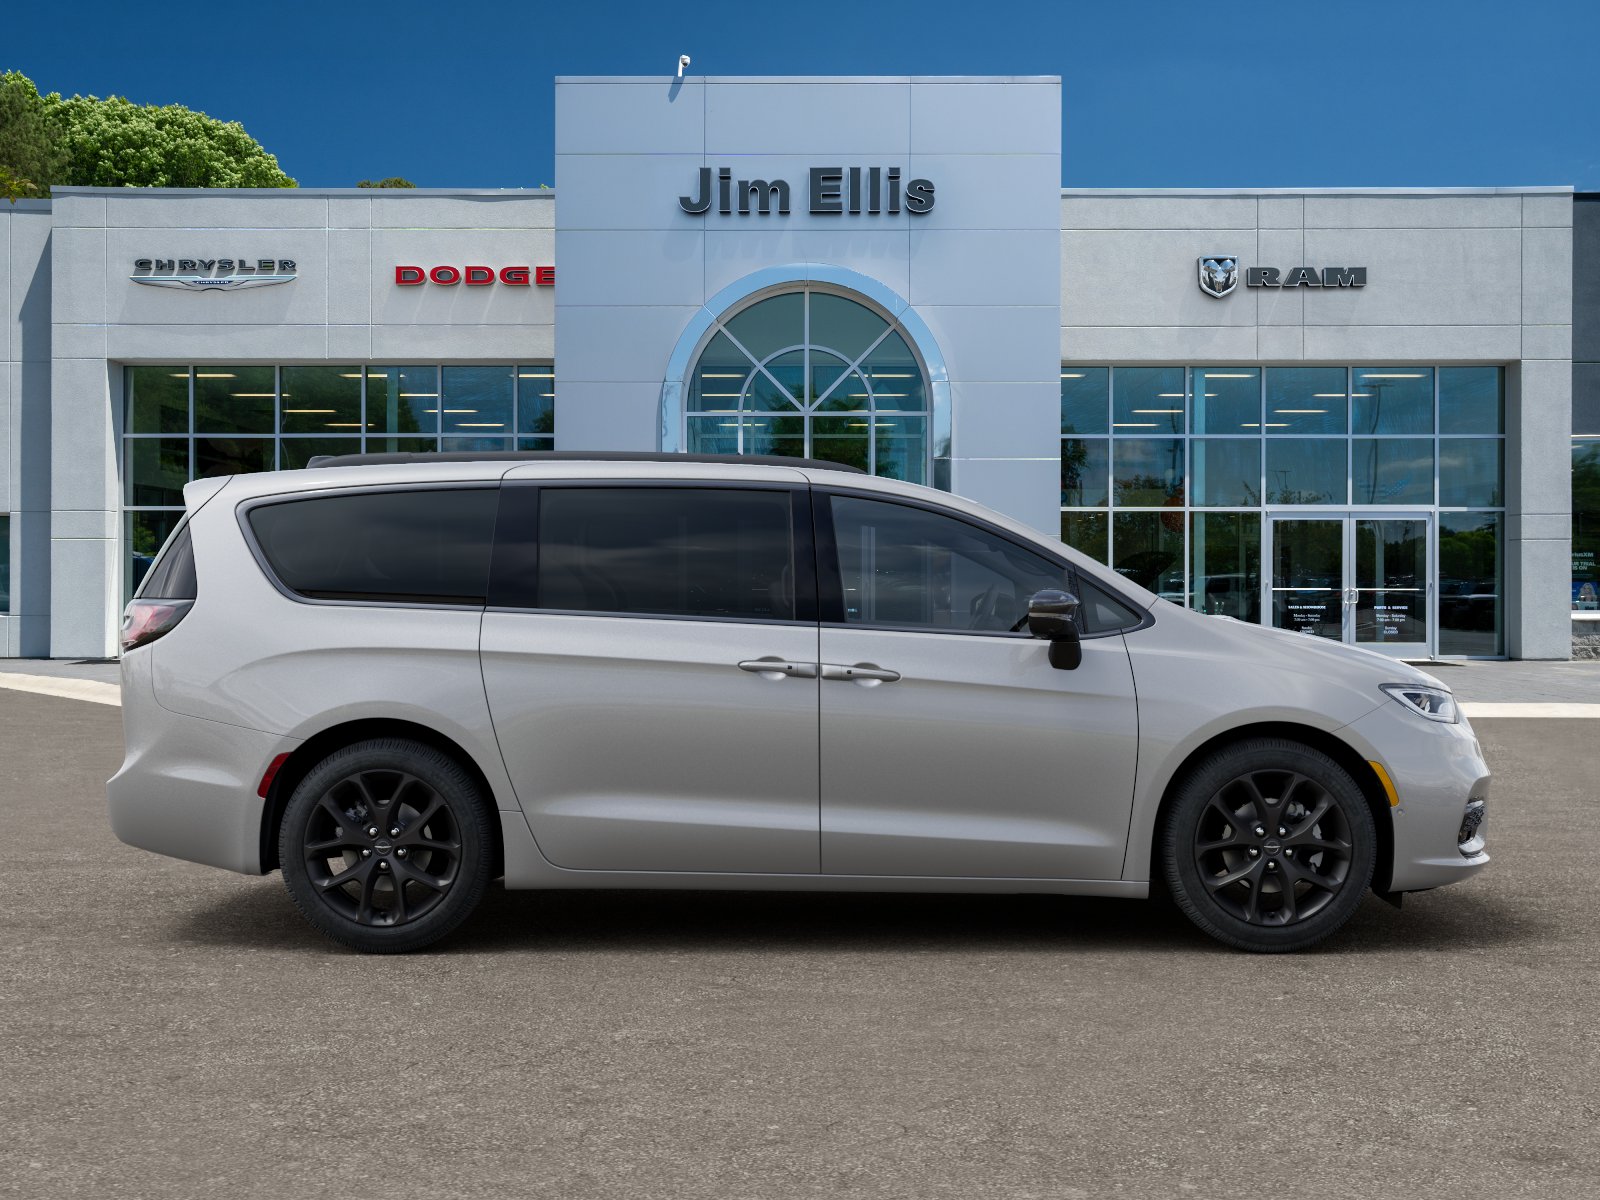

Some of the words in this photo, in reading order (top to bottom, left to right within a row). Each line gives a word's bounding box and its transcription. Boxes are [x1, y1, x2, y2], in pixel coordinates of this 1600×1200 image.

[679, 167, 790, 213] Jim
[809, 167, 935, 213] Ellis
[134, 259, 297, 271] CHRYSLER
[395, 265, 555, 287] DODGE
[1247, 267, 1367, 287] RAM
